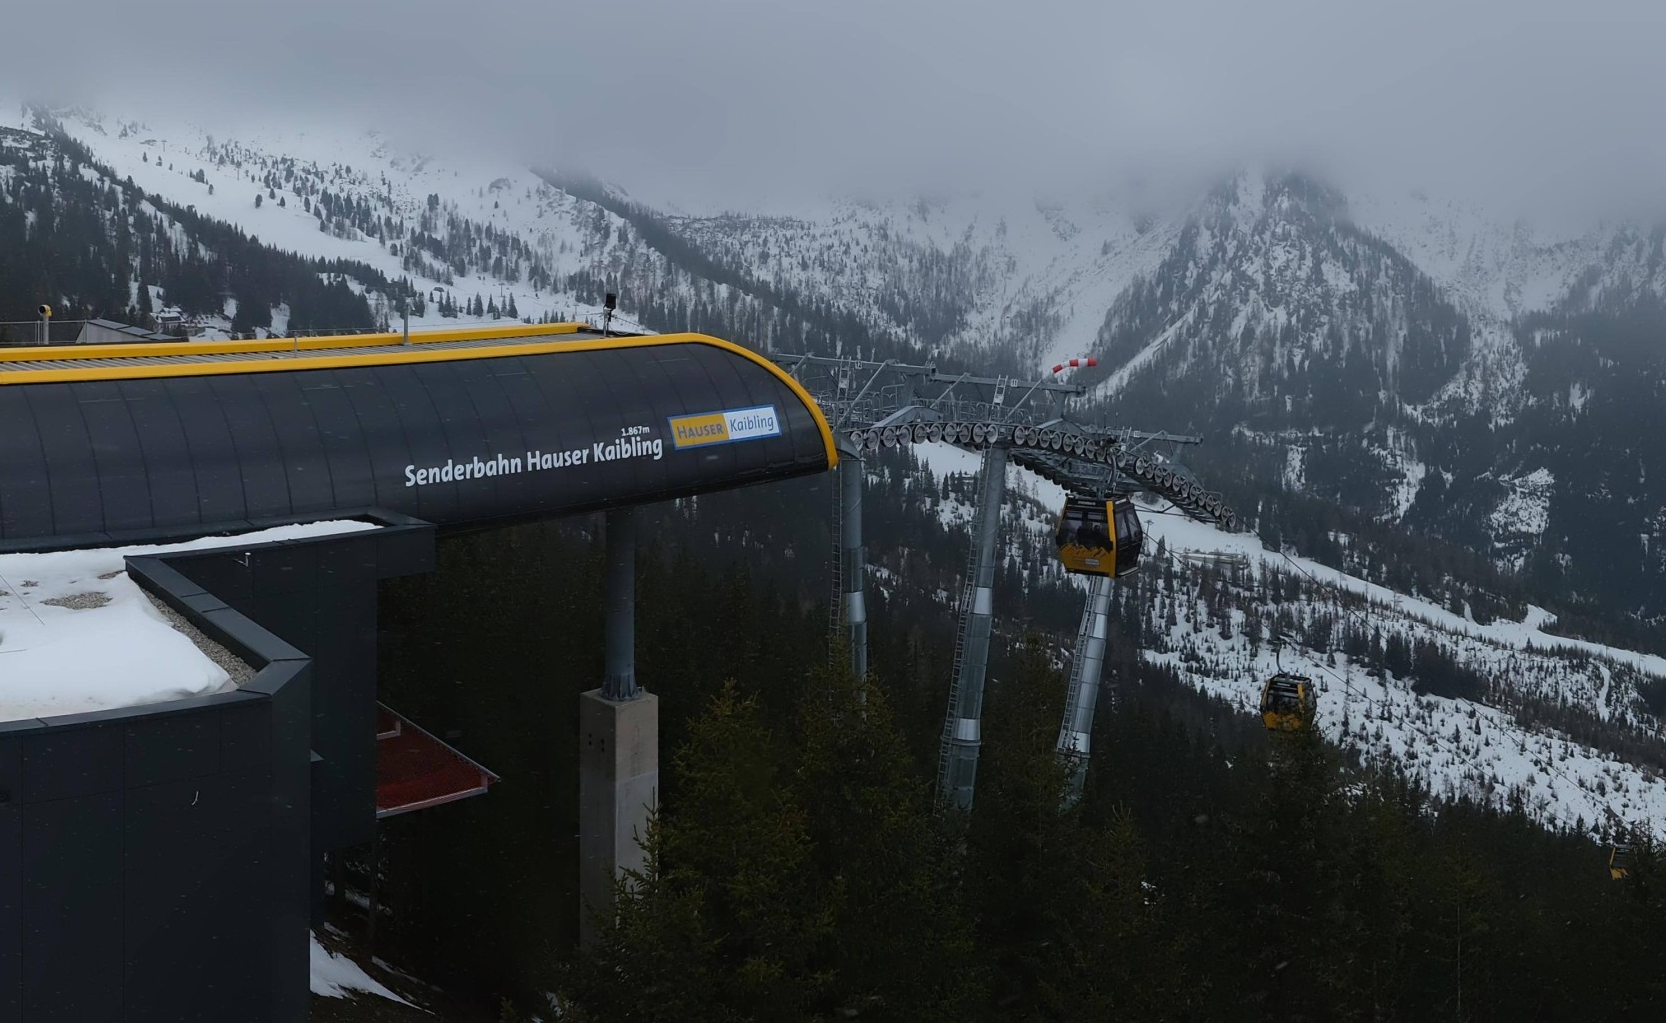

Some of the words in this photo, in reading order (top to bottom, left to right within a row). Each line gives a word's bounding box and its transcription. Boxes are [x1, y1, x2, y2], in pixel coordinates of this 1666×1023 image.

[677, 423, 723, 439] HAUSER
[730, 415, 774, 432] Kaibling
[404, 453, 522, 487] Senderbahn
[527, 449, 589, 472] Hauser
[593, 436, 663, 462] Kaibling
